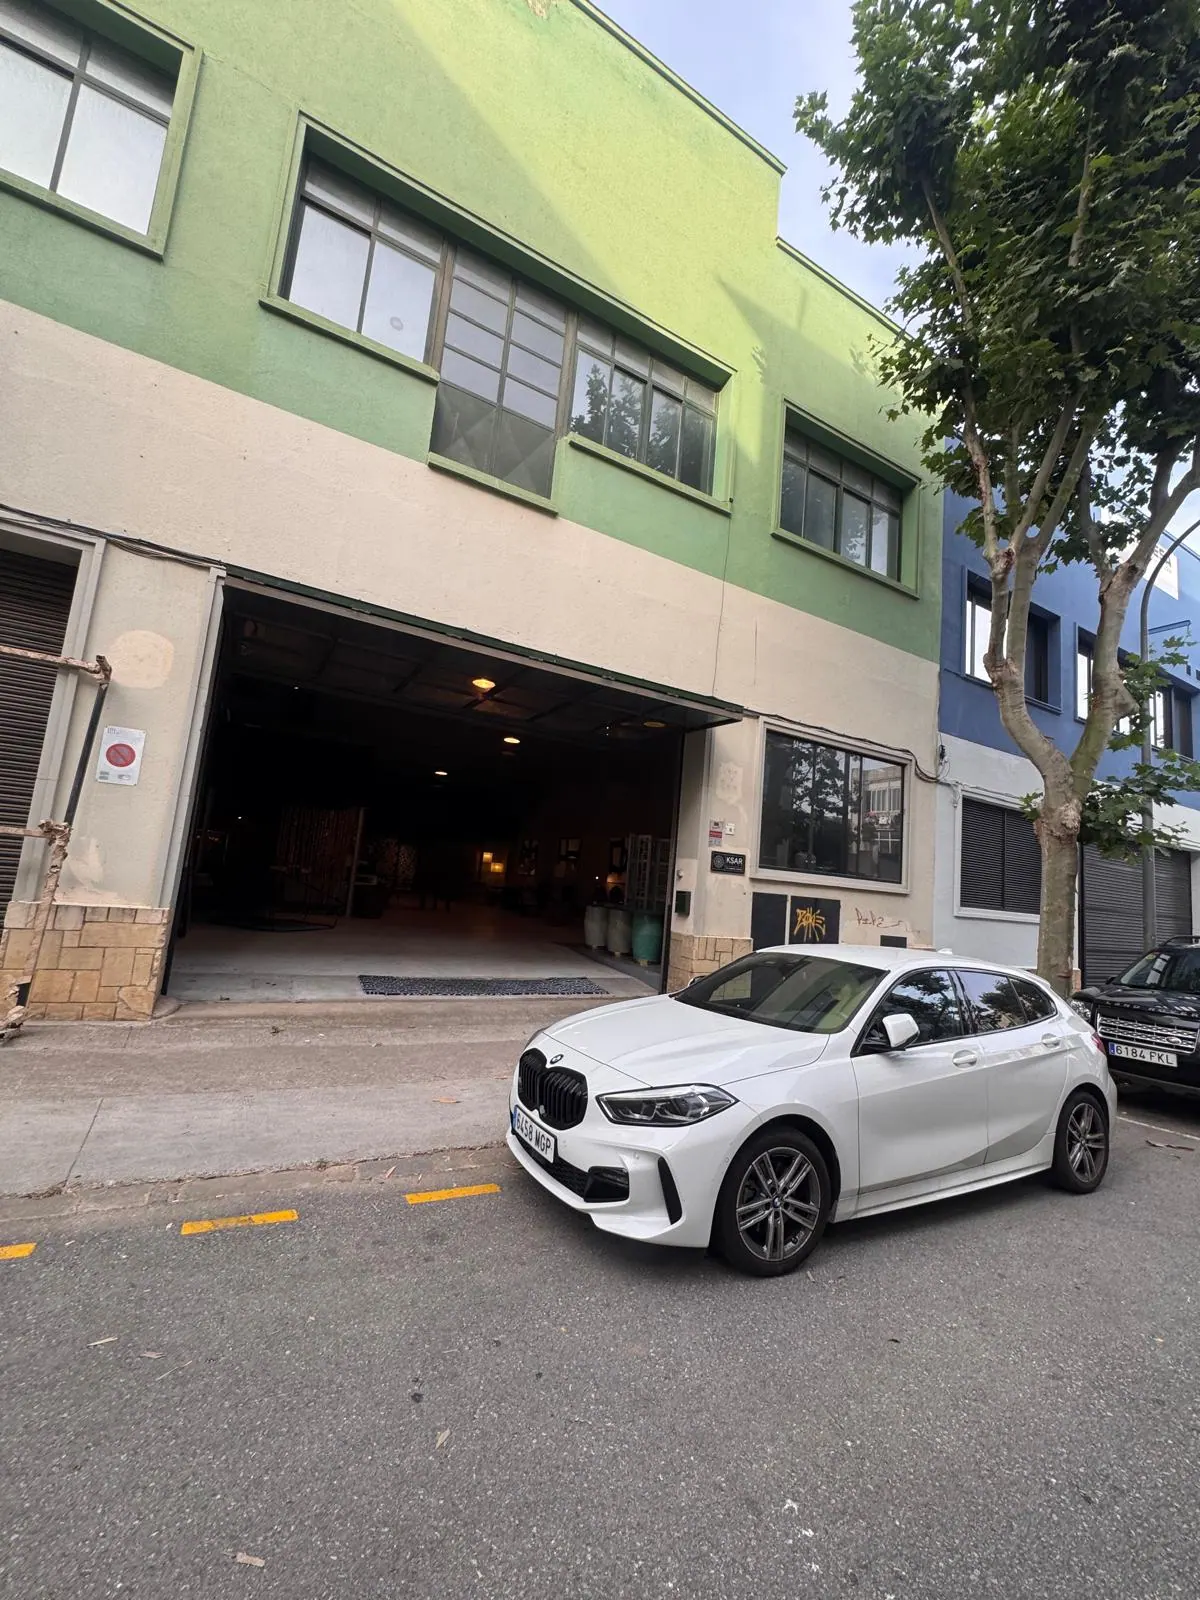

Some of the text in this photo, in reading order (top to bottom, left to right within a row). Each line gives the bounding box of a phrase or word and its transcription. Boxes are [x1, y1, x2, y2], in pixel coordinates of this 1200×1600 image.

[726, 856, 743, 865] KSAR
[1115, 1045, 1146, 1060] 6184
[534, 1129, 551, 1154] MGP
